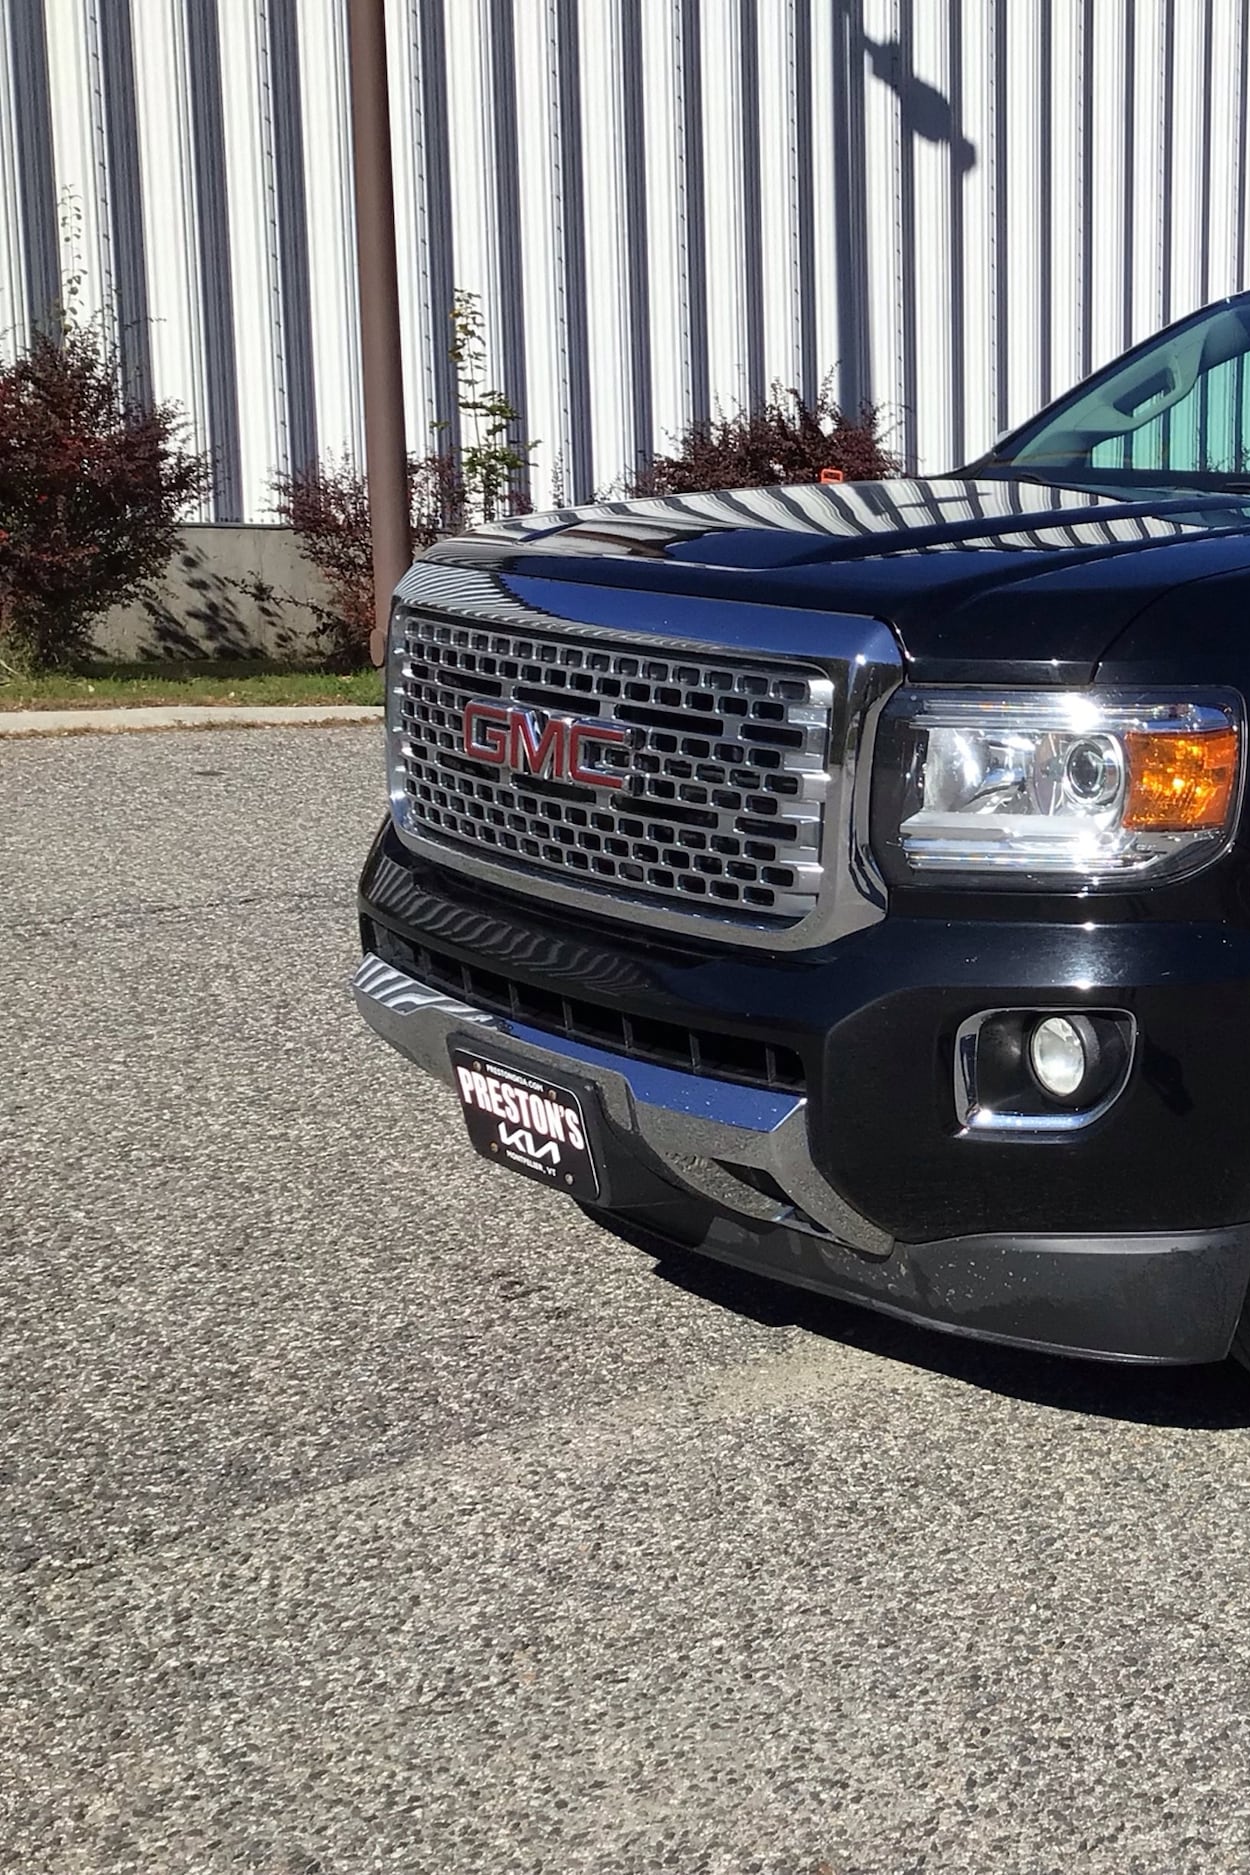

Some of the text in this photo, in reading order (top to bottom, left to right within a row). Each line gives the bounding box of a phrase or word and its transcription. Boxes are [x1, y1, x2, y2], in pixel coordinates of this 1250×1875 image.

[464, 699, 639, 795] GMC
[457, 1065, 585, 1150] PRESTON'S
[498, 1121, 561, 1165] KIA
